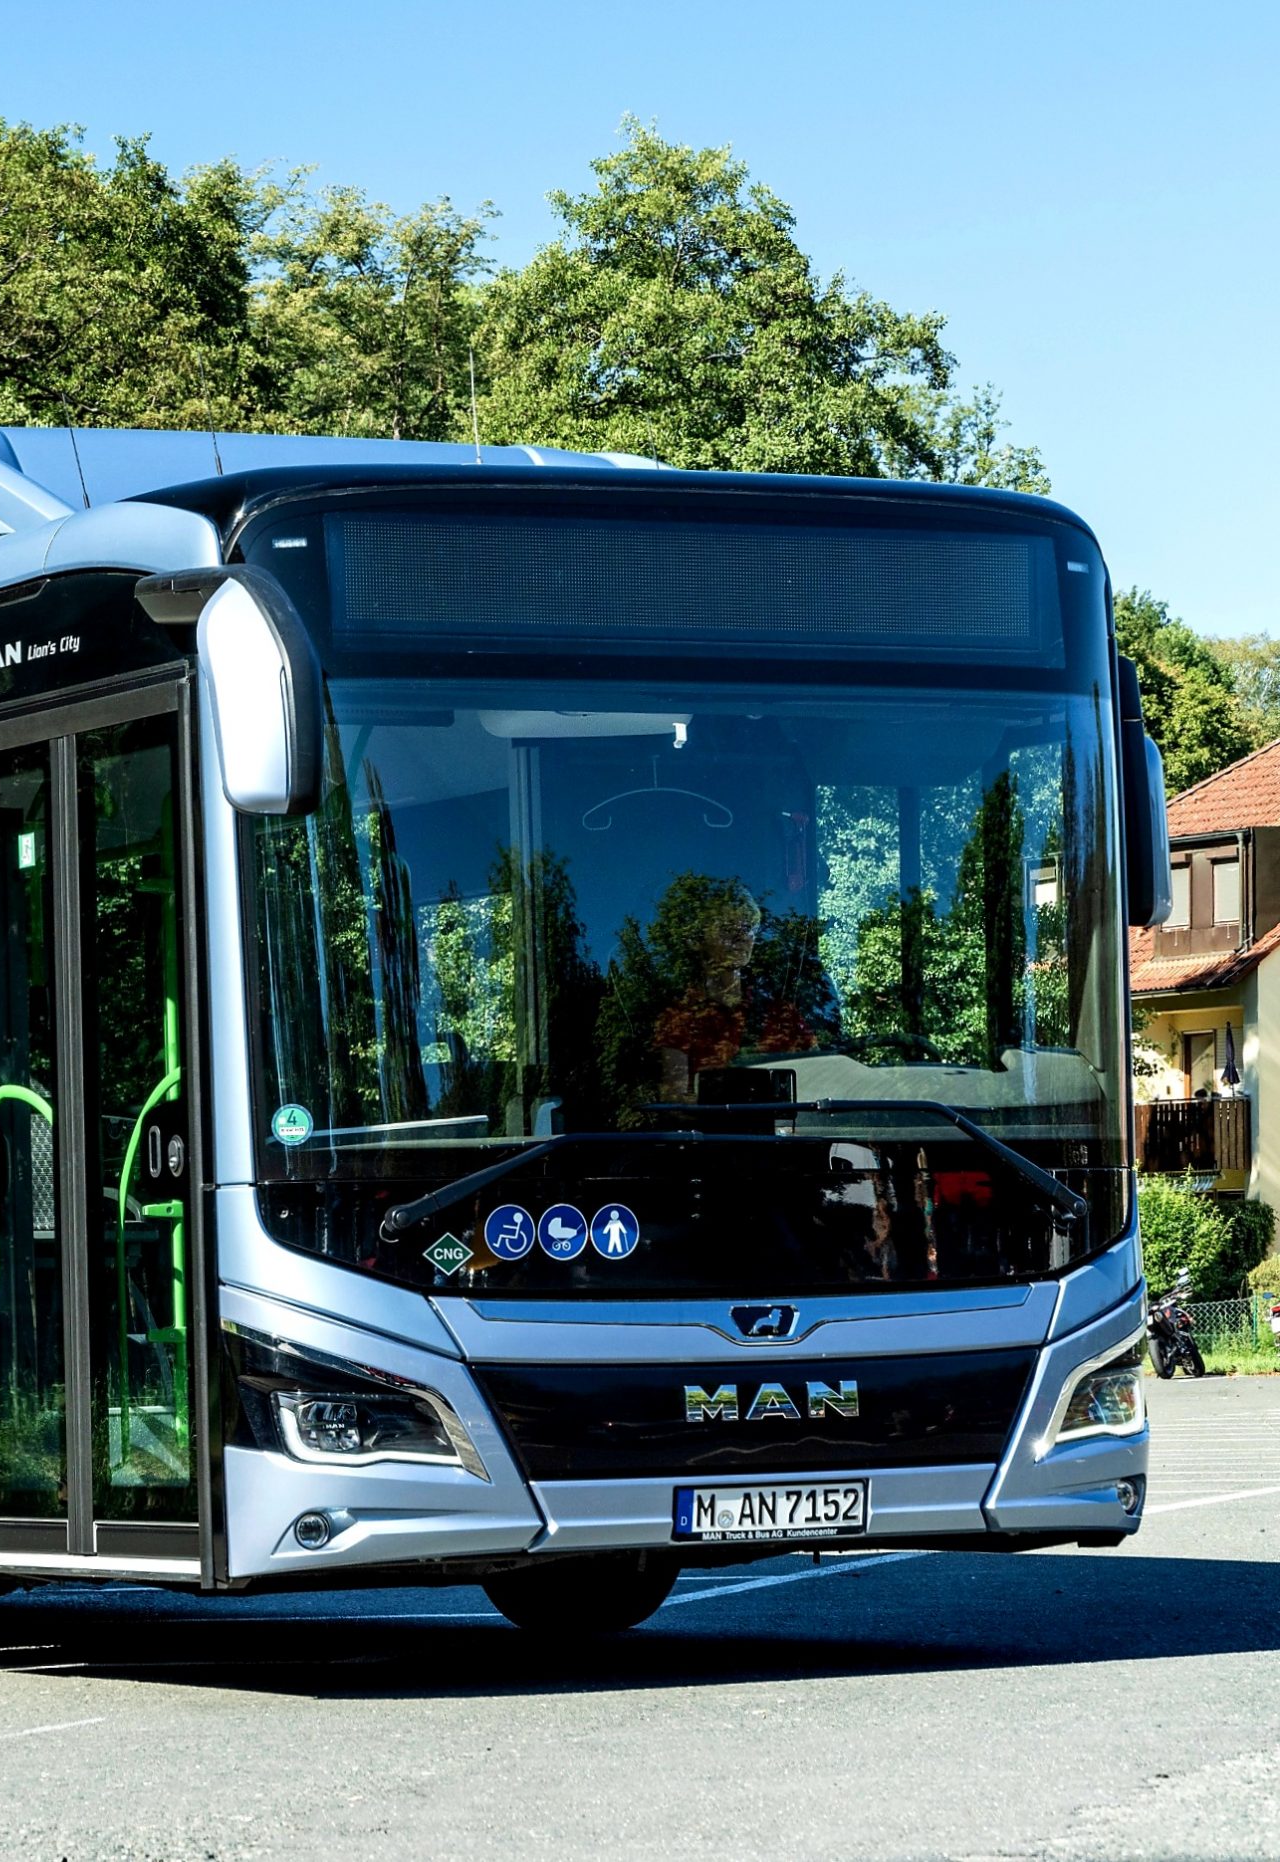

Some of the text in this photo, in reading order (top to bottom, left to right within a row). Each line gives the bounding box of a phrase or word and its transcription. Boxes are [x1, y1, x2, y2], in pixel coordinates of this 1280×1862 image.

[27, 640, 57, 661] Lion's
[60, 635, 80, 653] City
[286, 1109, 297, 1125] 4
[433, 1243, 464, 1260] CNG
[684, 1380, 860, 1422] MAN
[680, 1487, 860, 1528] D M AN 7152
[702, 1527, 838, 1541] MAN Truck & Bus AG Kundencenter
